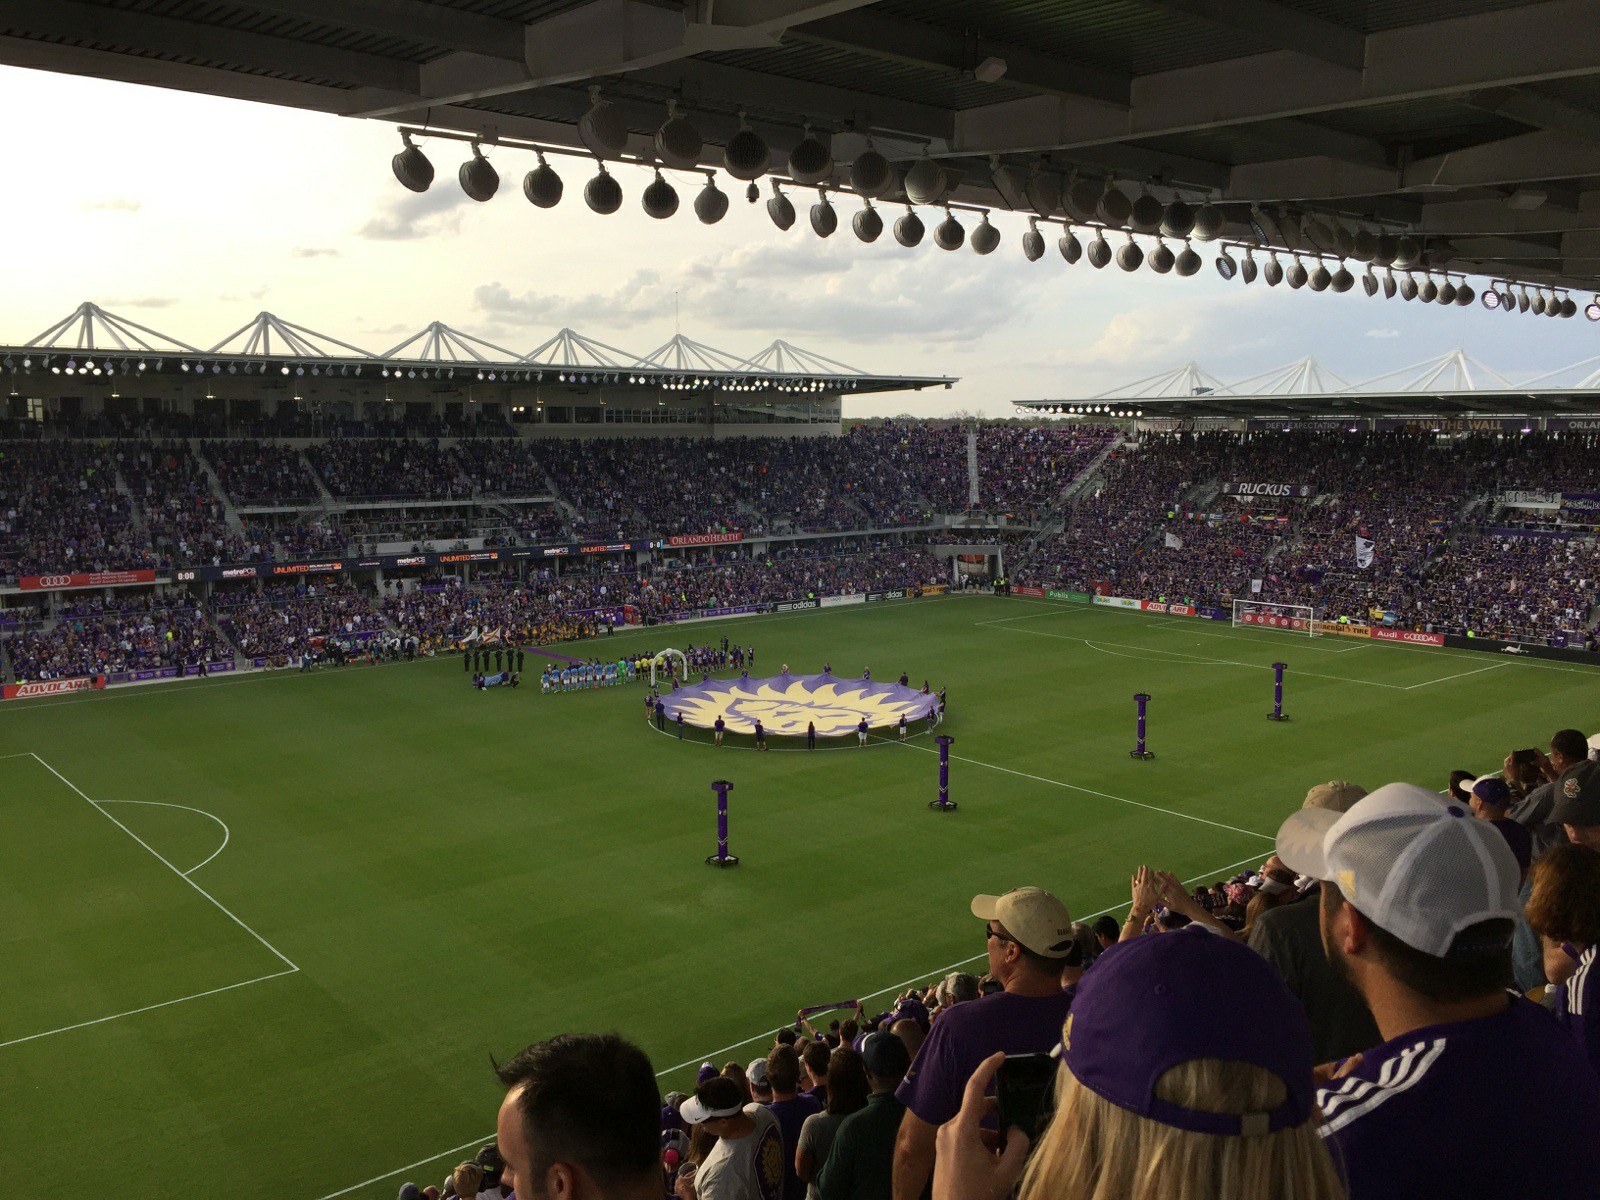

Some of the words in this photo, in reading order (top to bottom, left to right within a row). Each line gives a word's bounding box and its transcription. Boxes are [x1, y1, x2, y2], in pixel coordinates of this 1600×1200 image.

[1265, 421, 1285, 430] DEFY
[1440, 420, 1463, 430] THE
[1467, 420, 1503, 430] WALL
[1238, 482, 1291, 496] RUCKUS
[671, 536, 710, 546] ORLANDO
[710, 533, 739, 543] HEALTH
[580, 545, 607, 553] UNLIMITED
[440, 553, 471, 563] UNLIMITED
[273, 565, 310, 574] UNLIMITED
[792, 601, 817, 611] adidas
[1147, 602, 1188, 615] ADVARE
[1352, 627, 1369, 636] TIRE
[1377, 630, 1398, 639] Audi
